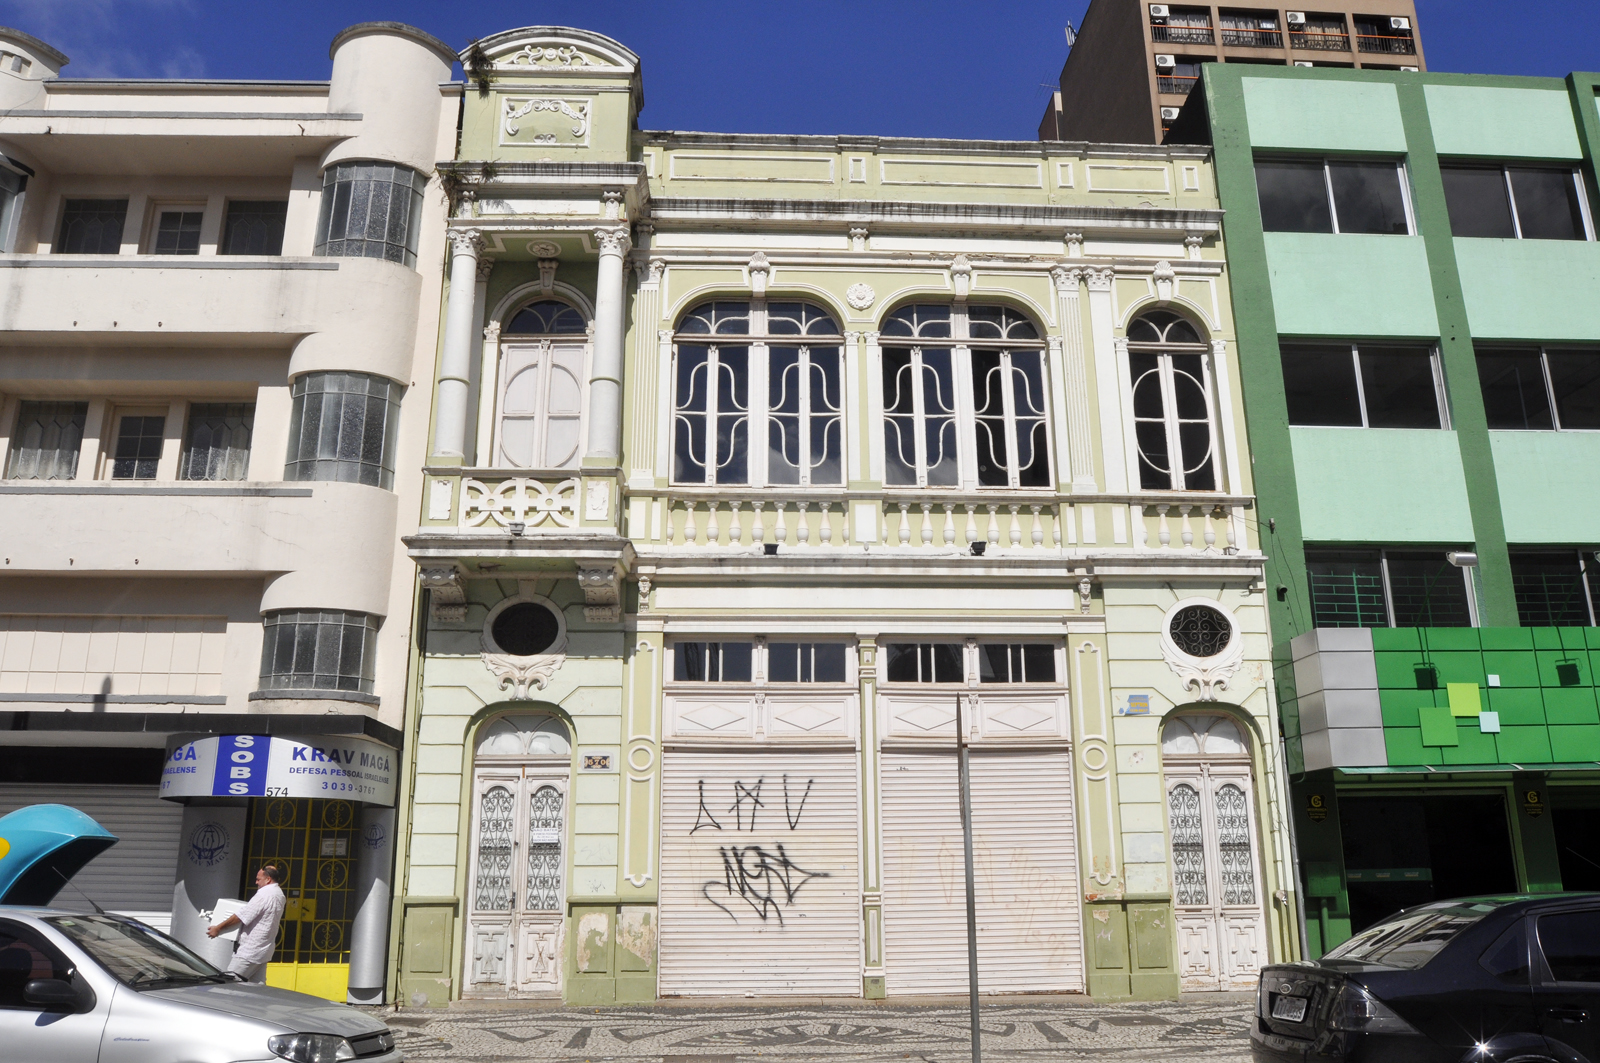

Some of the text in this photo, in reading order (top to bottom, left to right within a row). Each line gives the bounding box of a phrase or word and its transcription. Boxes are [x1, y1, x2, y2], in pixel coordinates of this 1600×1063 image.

[228, 735, 255, 795] SOBS
[292, 746, 391, 773] KRAV MAGÁ
[289, 766, 390, 785] DEFESA PESSOAL ISRAELENSE
[266, 786, 289, 798] 574
[321, 781, 376, 795] 3039-3767
